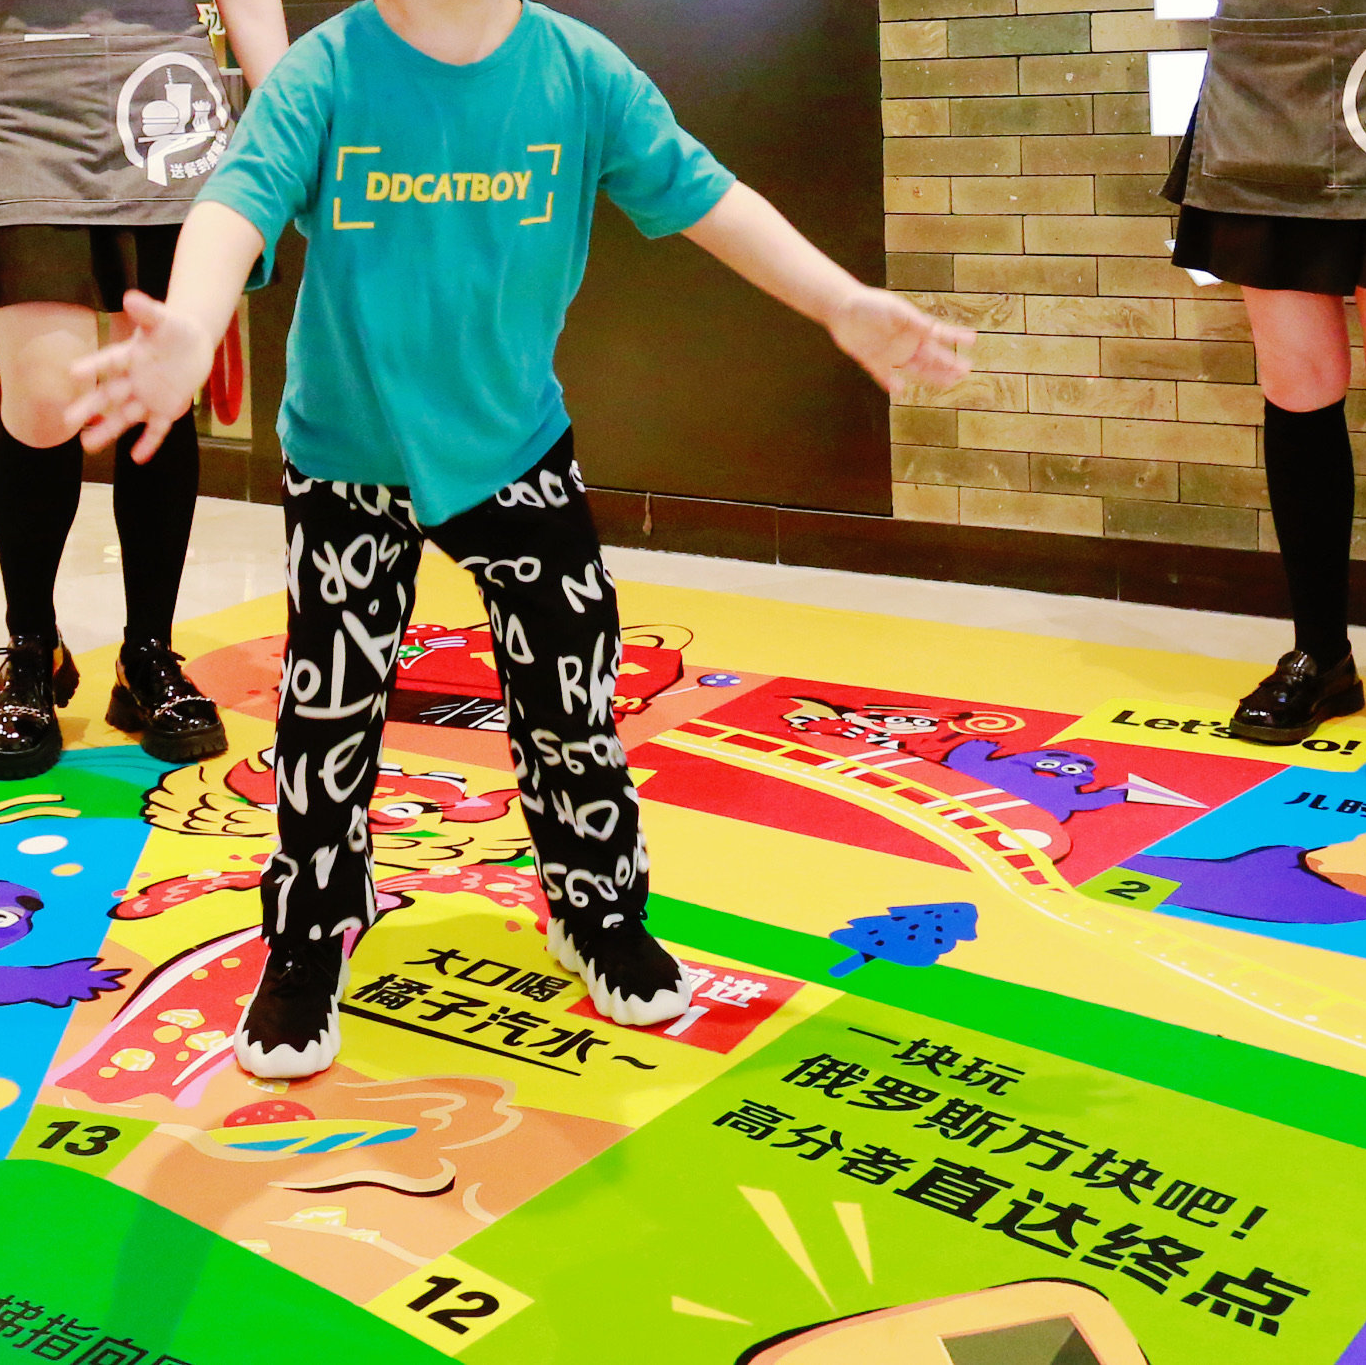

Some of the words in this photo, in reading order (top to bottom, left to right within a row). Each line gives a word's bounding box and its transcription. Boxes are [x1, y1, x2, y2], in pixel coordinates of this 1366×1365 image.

[366, 170, 534, 203] DDCATBOY
[1301, 738, 1363, 756] o!
[1107, 879, 1153, 901] 2
[402, 947, 577, 1003] 大口喝
[846, 1026, 1027, 1097] 一块玩
[36, 1118, 122, 1157] 13
[781, 1052, 1268, 1241] 俄罗斯方块吧！
[711, 1098, 1311, 1337] 高分者直达终点
[405, 1276, 501, 1334] 12
